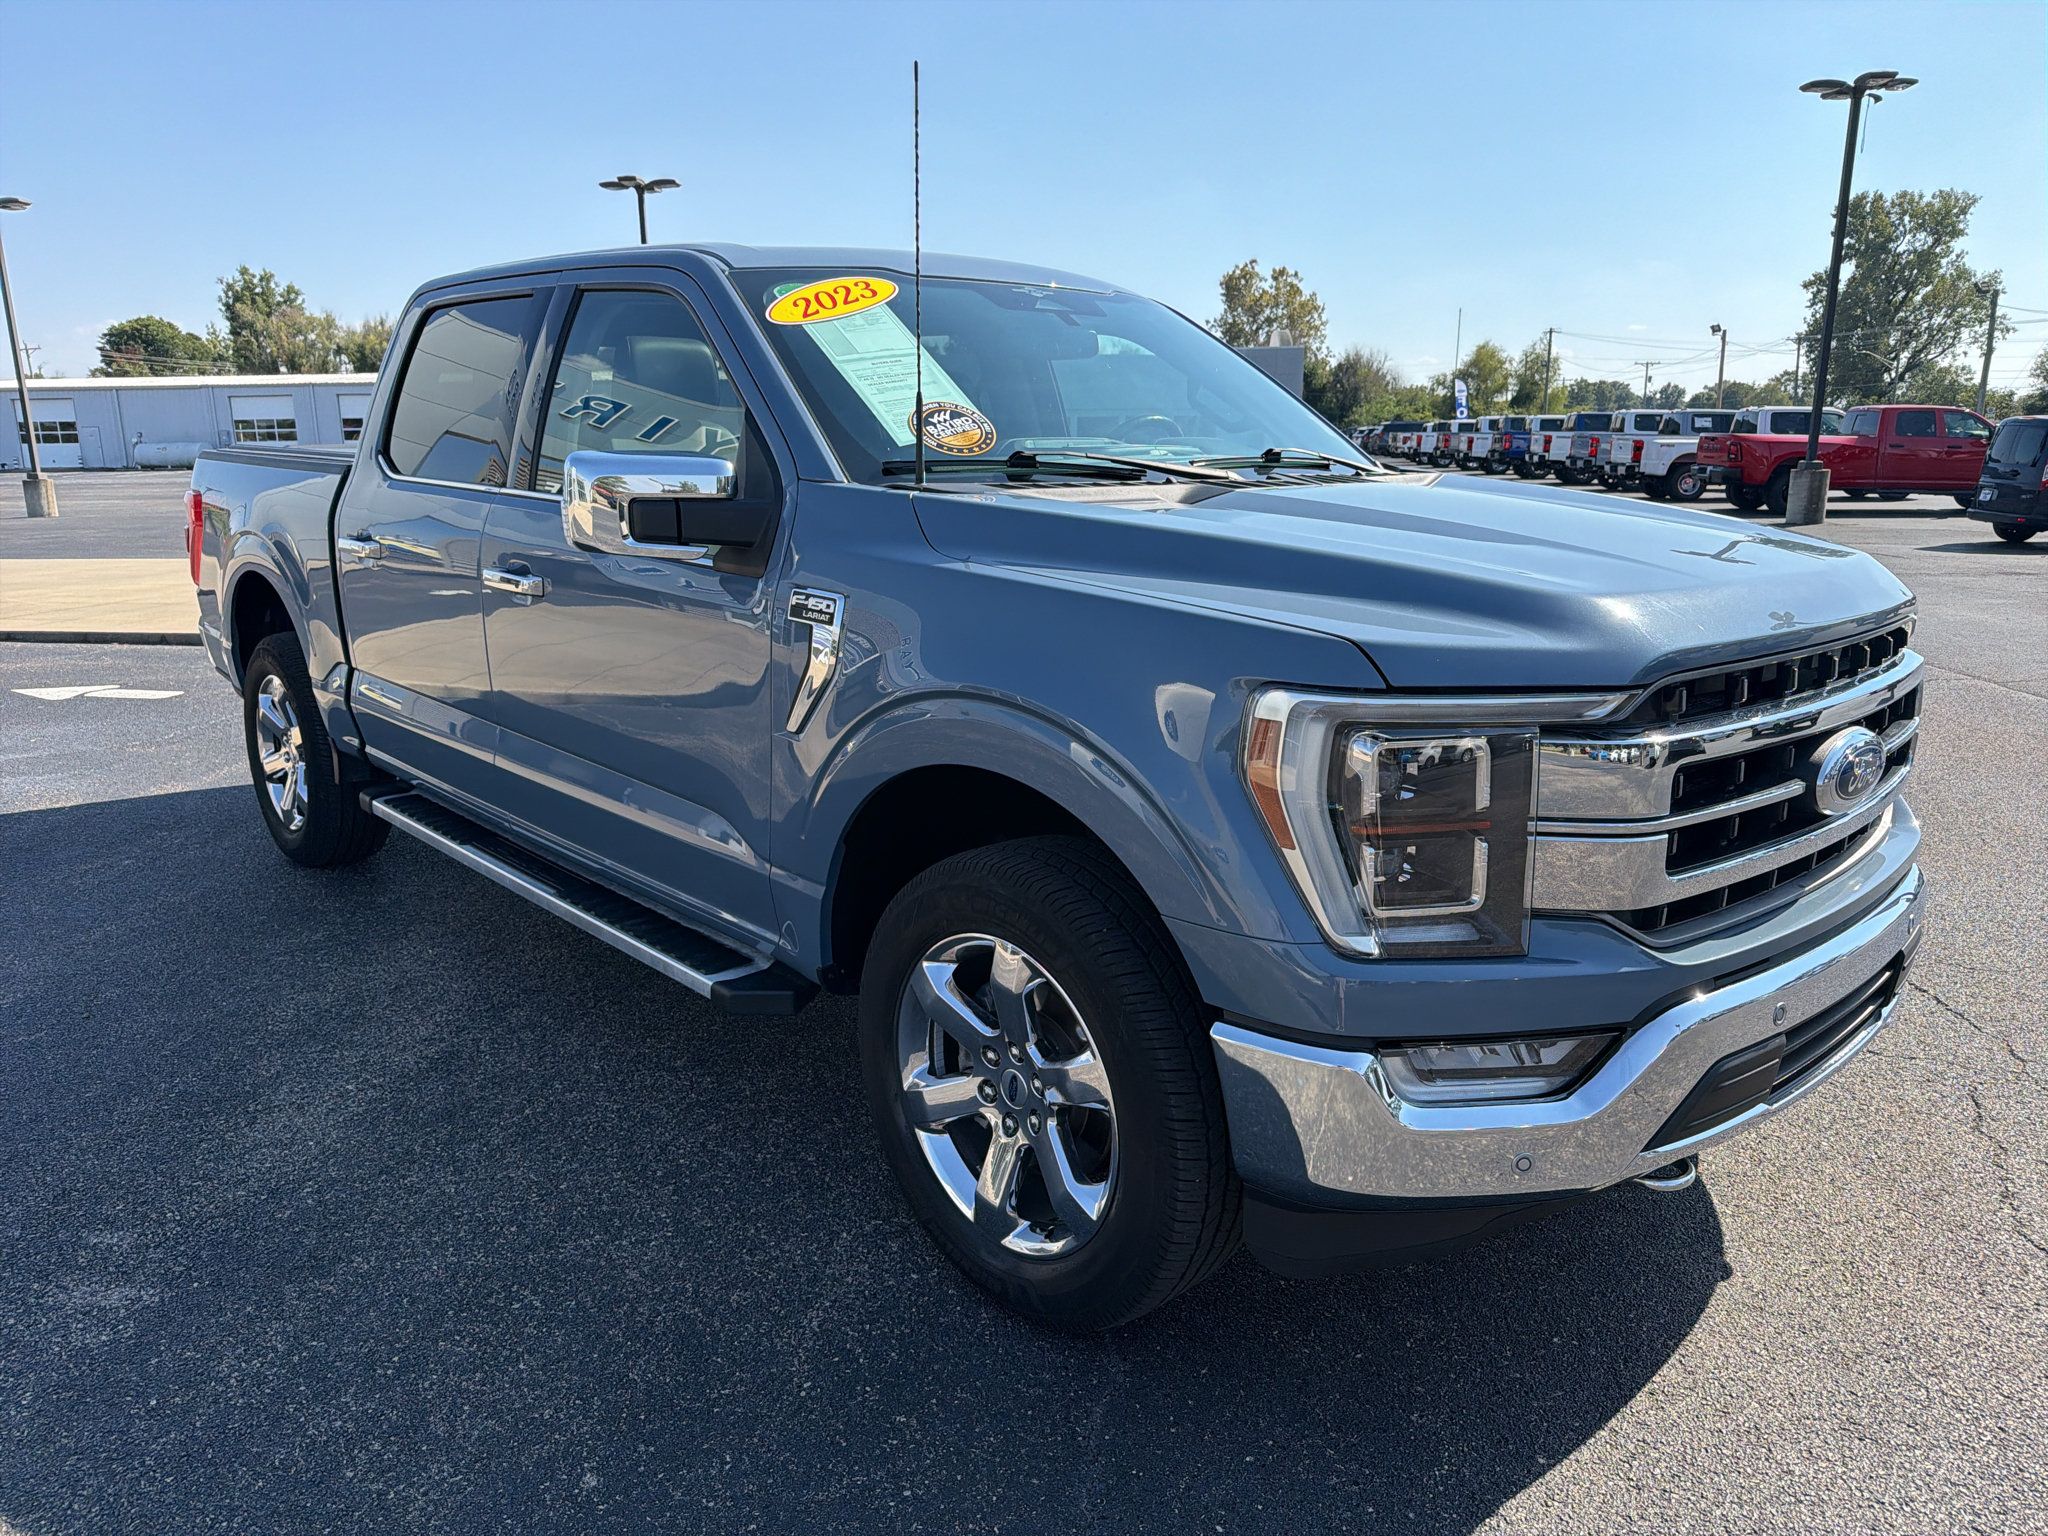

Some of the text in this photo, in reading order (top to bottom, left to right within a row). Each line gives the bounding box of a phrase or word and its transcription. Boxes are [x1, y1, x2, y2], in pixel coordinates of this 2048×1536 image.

[793, 281, 878, 319] 2023
[957, 405, 973, 415] CAN
[926, 416, 973, 435] BAYIRD
[934, 423, 979, 439] CERTIFIED
[791, 594, 836, 613] F-150
[802, 610, 831, 622] LARIAT
